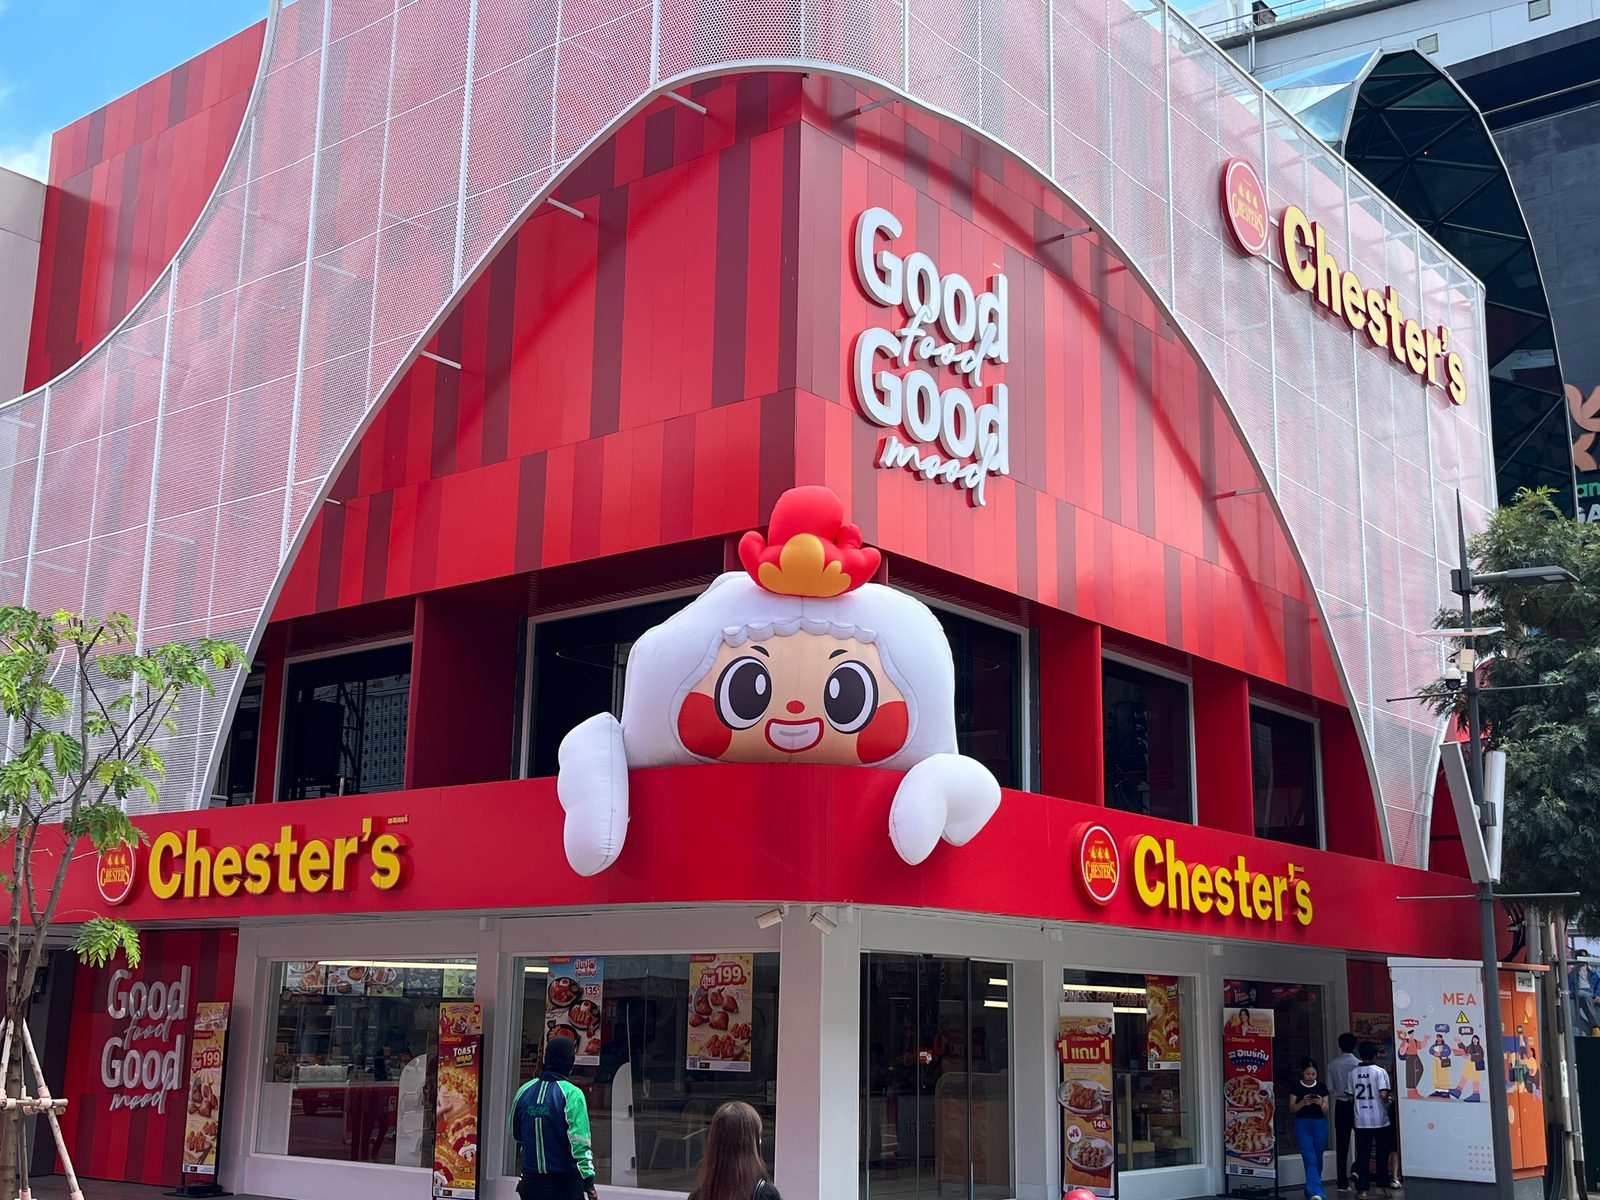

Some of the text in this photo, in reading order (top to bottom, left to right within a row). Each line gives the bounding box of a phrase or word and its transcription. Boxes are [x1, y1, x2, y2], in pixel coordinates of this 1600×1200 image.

[855, 207, 1009, 363] Good
[1280, 204, 1466, 405] Chester's
[896, 305, 997, 387] food
[854, 327, 1009, 475] Good
[879, 433, 998, 506] mood
[149, 817, 400, 899] Chester's
[1134, 835, 1313, 925] Chester's
[108, 965, 191, 1020] Good
[124, 1000, 178, 1049] food
[1443, 992, 1477, 1006] MEA
[102, 1034, 185, 1091] Good
[453, 1044, 477, 1057] TOAST
[1355, 1083, 1374, 1100] 21
